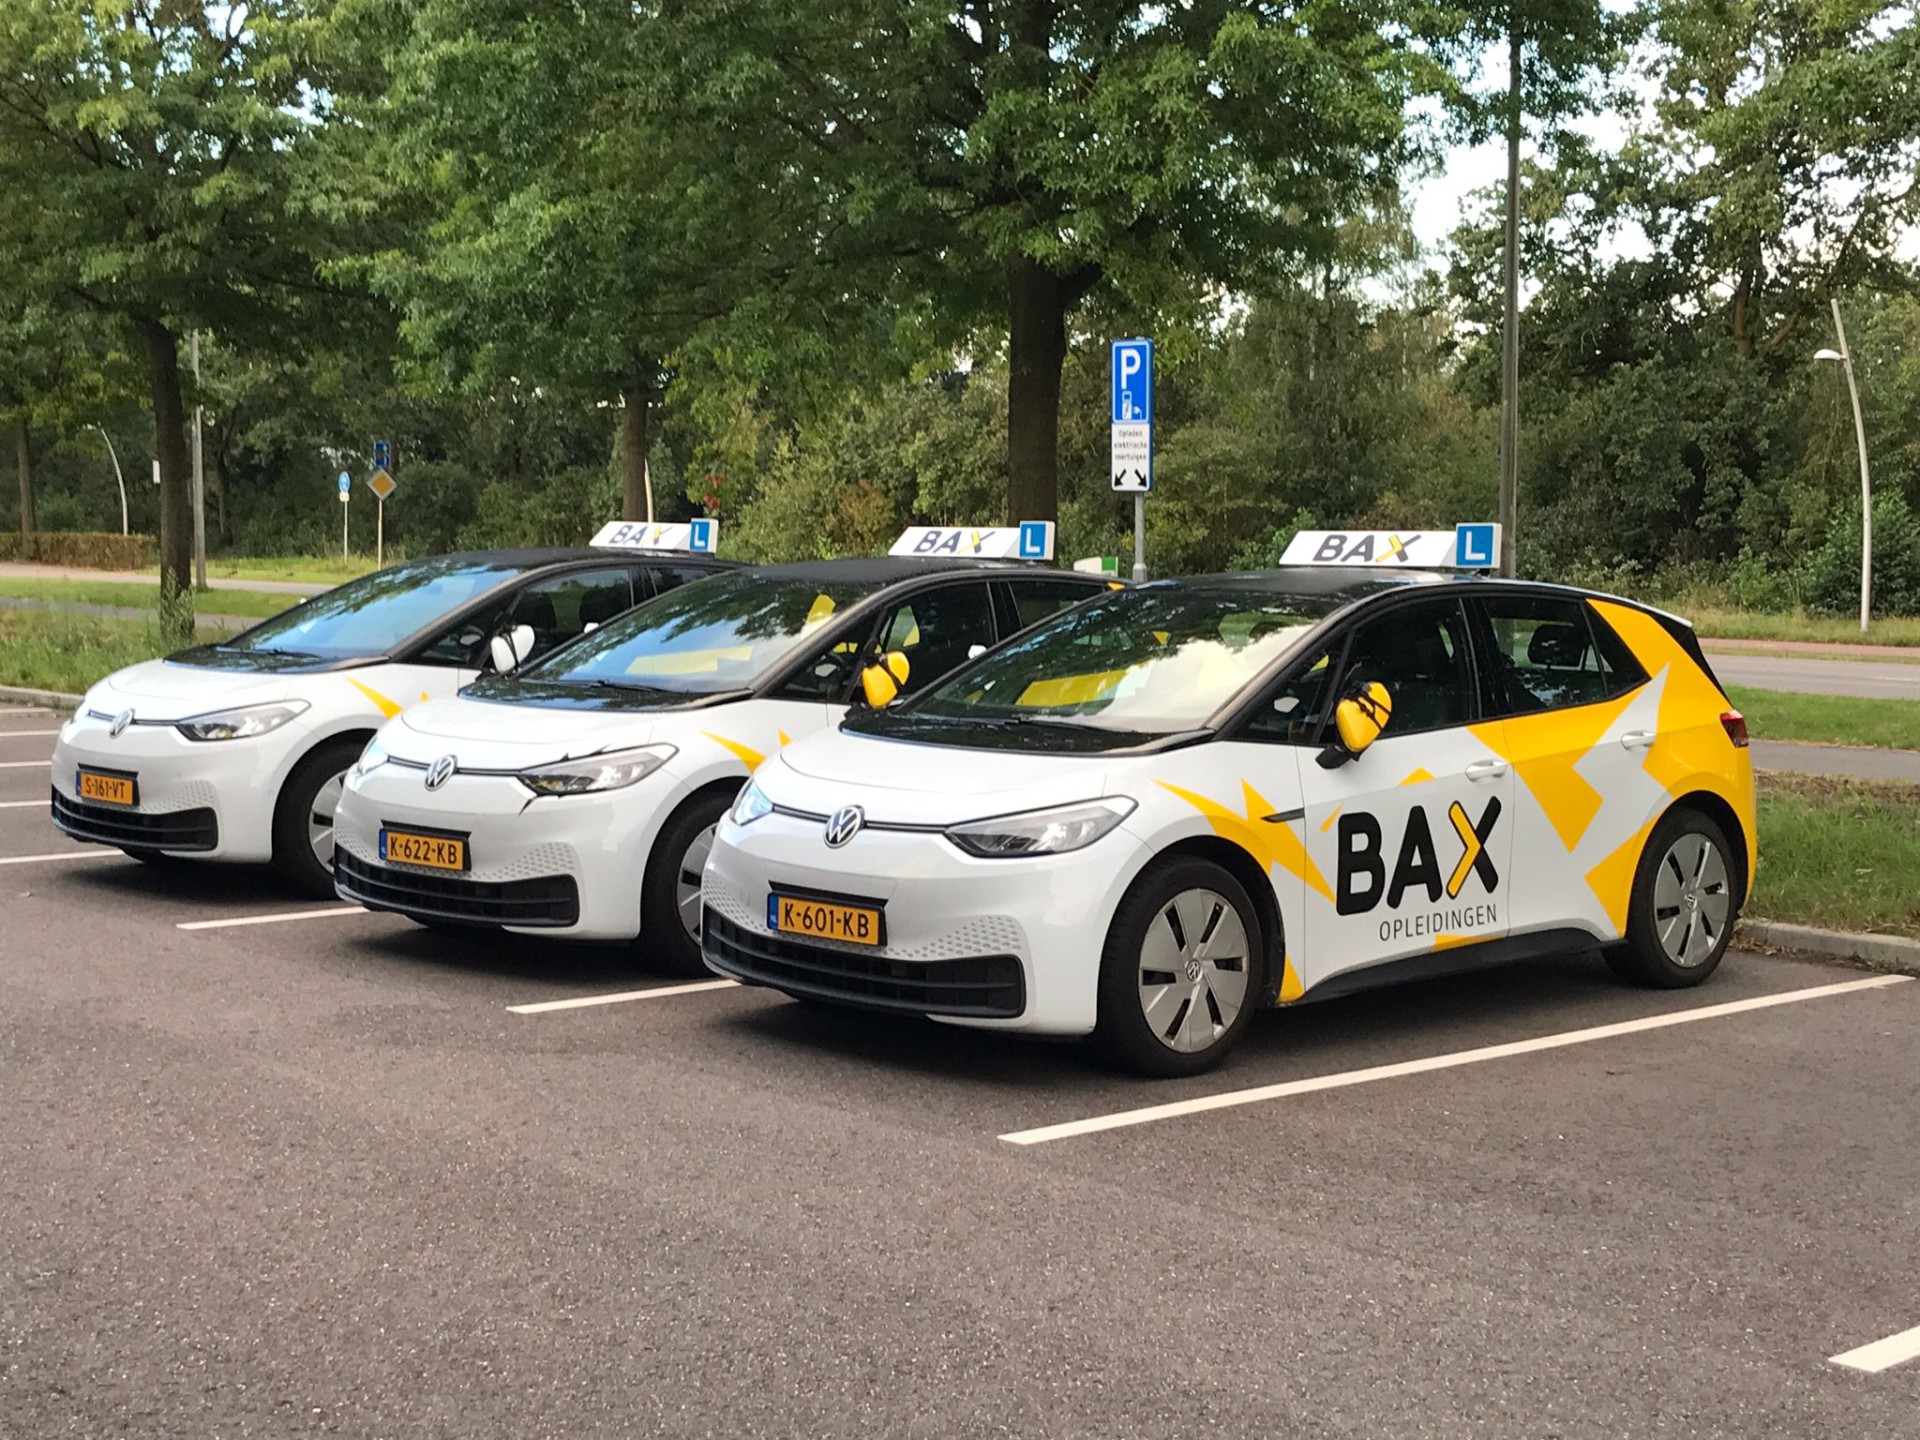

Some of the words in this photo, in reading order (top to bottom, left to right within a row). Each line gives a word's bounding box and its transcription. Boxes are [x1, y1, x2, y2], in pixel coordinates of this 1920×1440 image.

[1121, 348, 1141, 390] P
[608, 524, 674, 546] BAX
[693, 523, 706, 547] L
[913, 530, 996, 555] BAX
[1025, 527, 1041, 554] L
[1312, 533, 1422, 563] BAX
[1464, 530, 1486, 561] L
[85, 776, 126, 799] S-161-VT
[390, 836, 457, 865] K-622-KB
[1336, 795, 1502, 916] BAX
[784, 902, 869, 938] K-601-KB
[1379, 903, 1498, 942] OPLEIDINGEN
